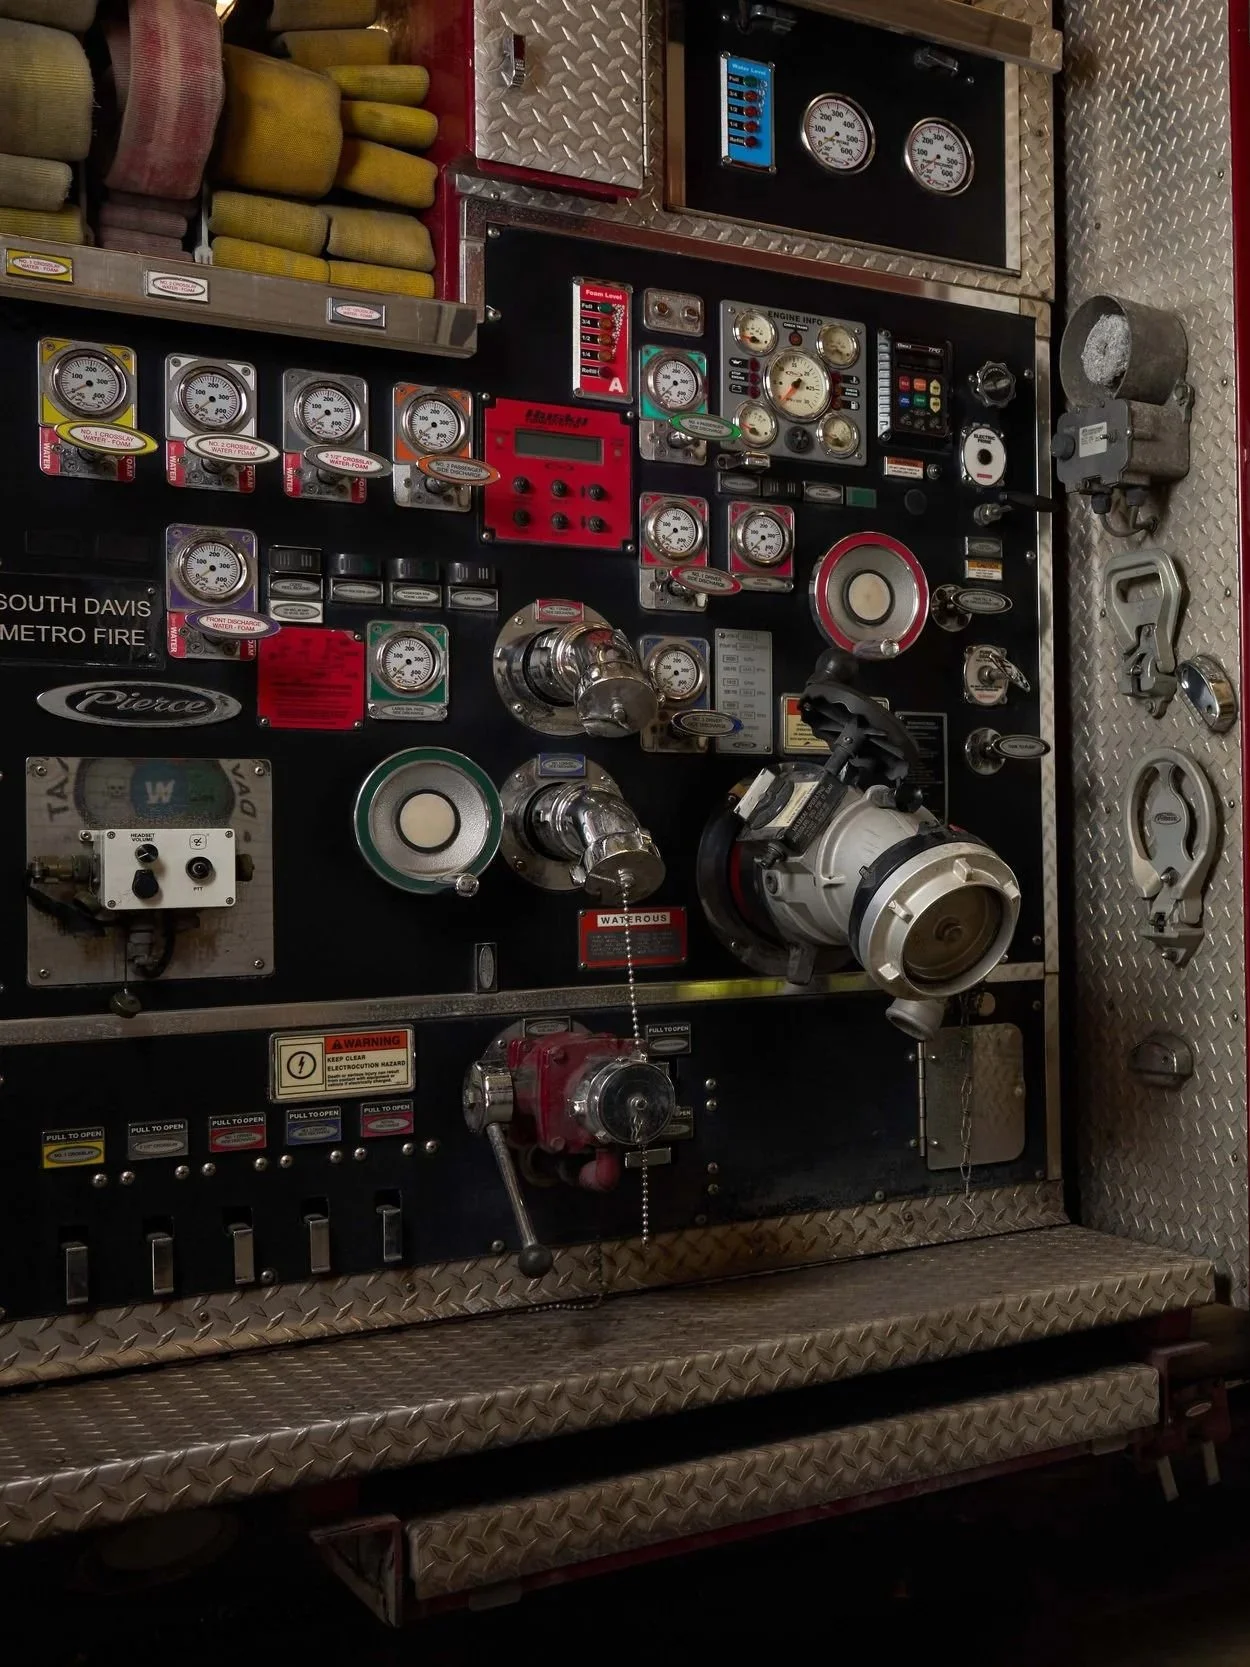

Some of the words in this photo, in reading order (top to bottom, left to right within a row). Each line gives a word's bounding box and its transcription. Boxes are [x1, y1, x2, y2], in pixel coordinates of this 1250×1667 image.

[732, 63, 749, 72] Water
[751, 67, 766, 76] Level
[820, 114, 832, 122] 200
[832, 110, 844, 118] 300
[815, 125, 826, 133] 100
[843, 121, 855, 129] 400
[846, 136, 858, 144] 500
[922, 137, 933, 145] 200
[841, 147, 853, 155] 600
[917, 148, 928, 156] 100
[944, 144, 955, 152] 400
[942, 169, 953, 177] 600
[585, 289, 604, 298] Foam
[605, 292, 622, 300] Level
[767, 310, 800, 323] ENGINE
[802, 316, 823, 326] INFO
[581, 367, 597, 375] Refill
[608, 377, 624, 393] A
[83, 435, 103, 444] WATER
[111, 438, 131, 447] FOAM
[99, 432, 134, 442] CROSSLAY
[211, 446, 230, 454] WATER
[236, 448, 255, 456] FOAM
[226, 442, 258, 452] CROSSLAY
[342, 455, 373, 465] CROSSLAY
[451, 464, 482, 472] PASSENGER
[0, 593, 76, 613] SOUTH
[84, 598, 151, 617] DAVIS
[228, 618, 261, 627] DISCHARGE
[0, 624, 86, 644] METRO
[94, 628, 145, 646] FIRE
[75, 689, 208, 713] Pierce
[601, 914, 667, 925] WATEROUS
[344, 1036, 400, 1048] WARNING
[328, 1063, 379, 1071] ELECTROCUTION
